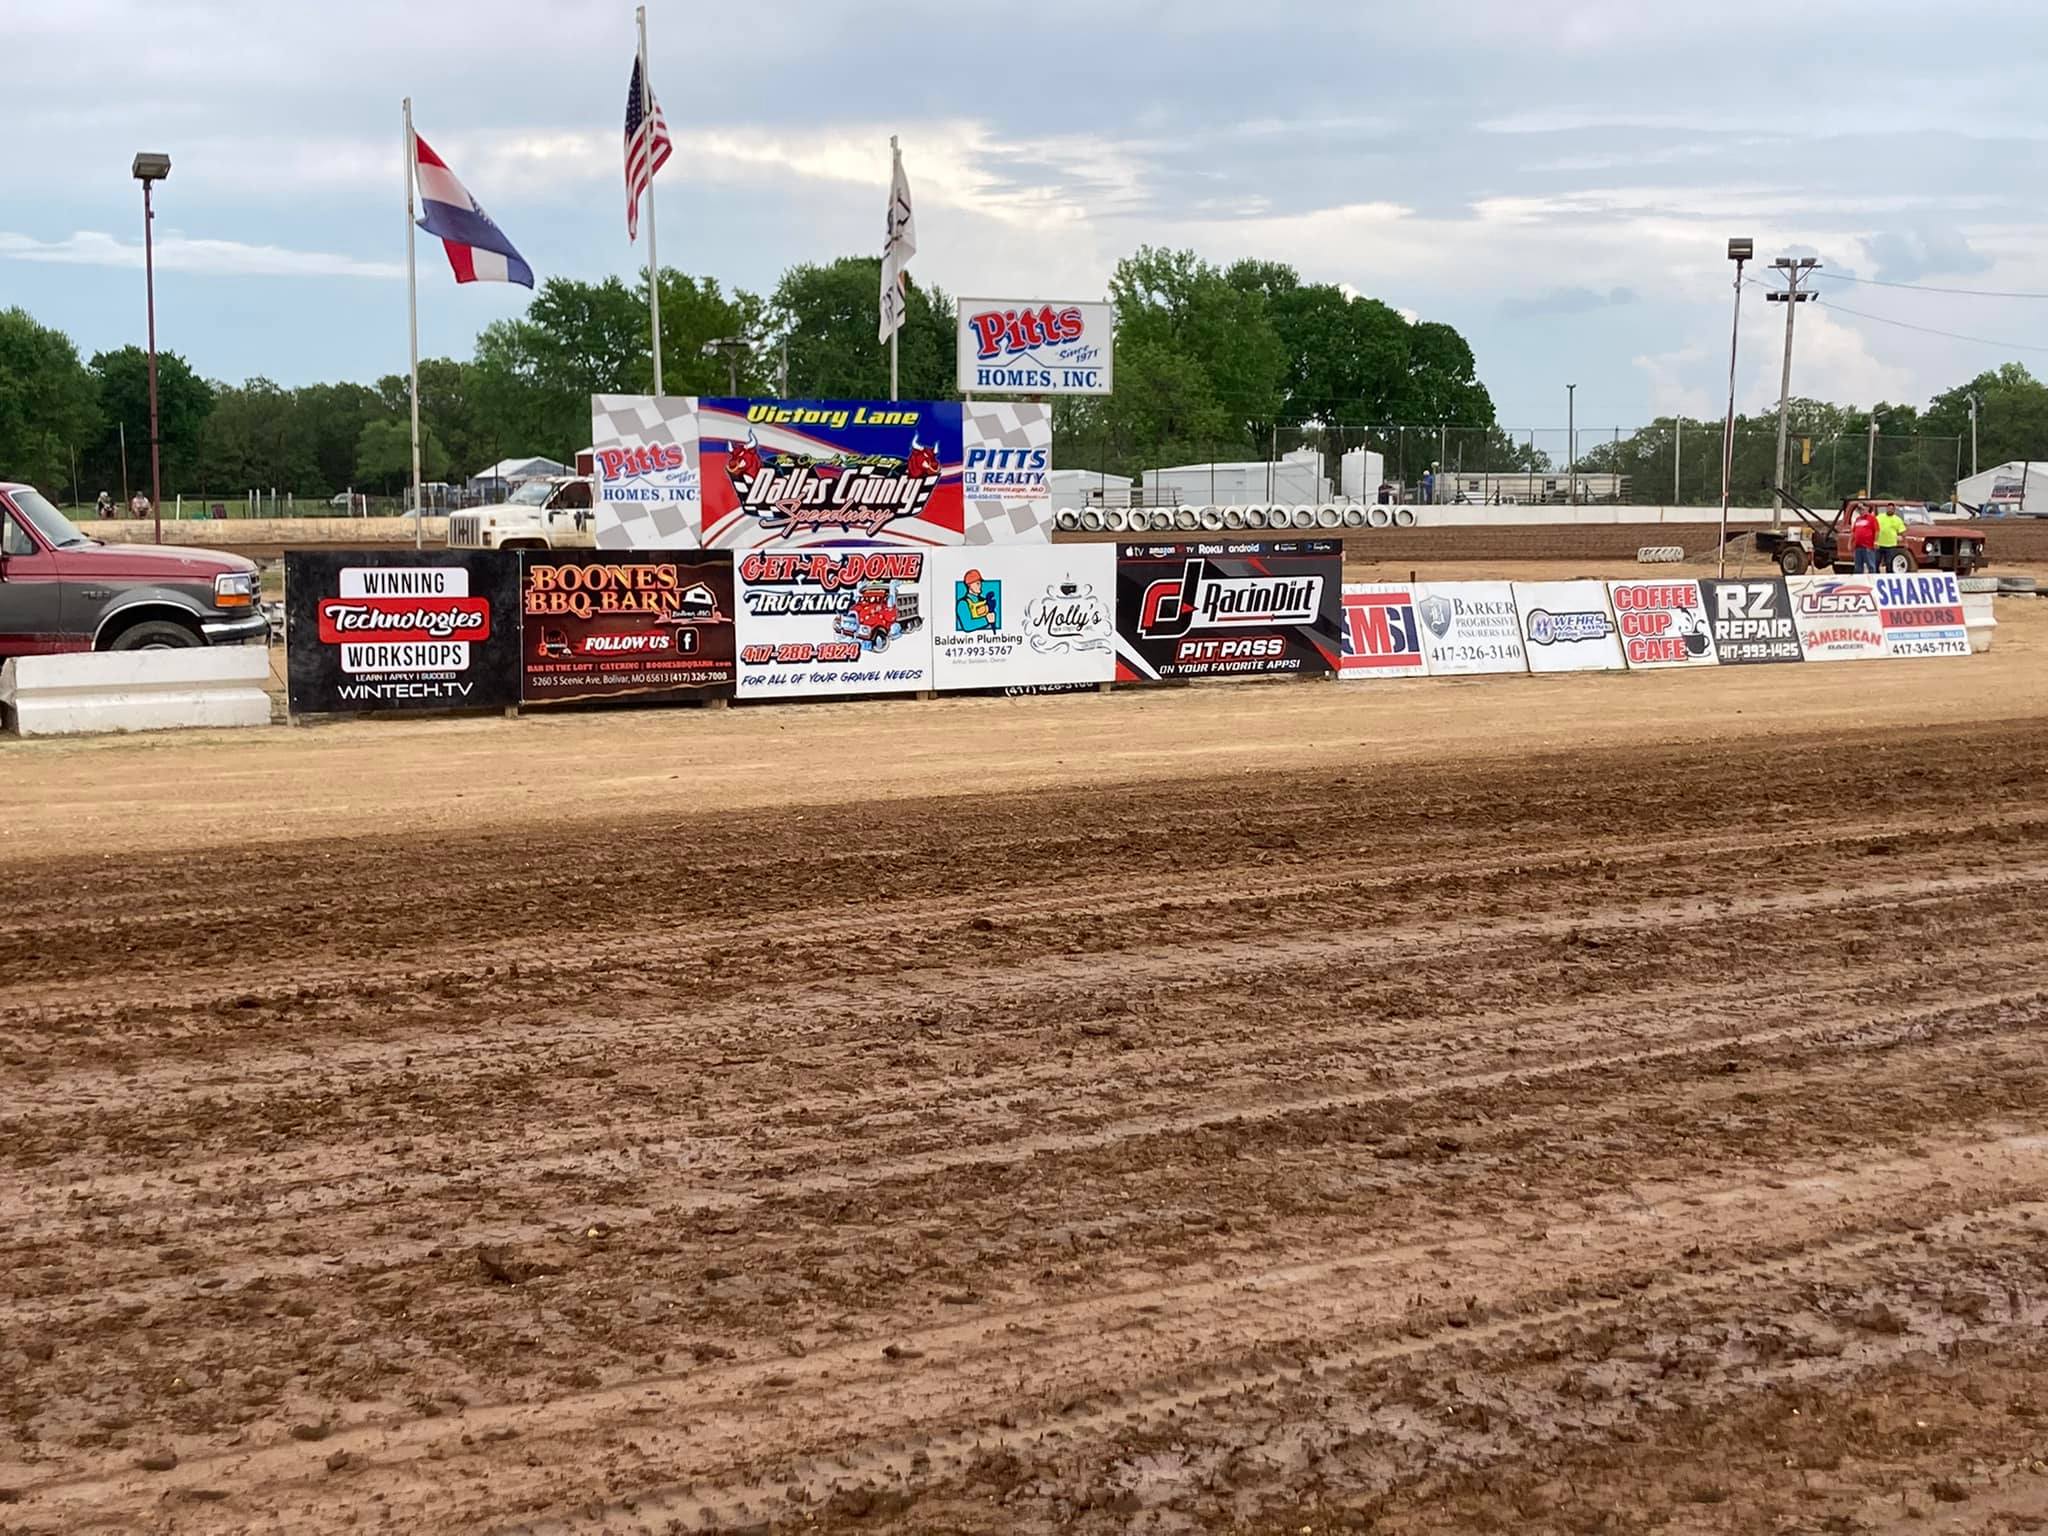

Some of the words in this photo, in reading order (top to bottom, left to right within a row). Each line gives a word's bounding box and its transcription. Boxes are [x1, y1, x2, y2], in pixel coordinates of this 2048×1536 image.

[968, 304, 1085, 360] Pitts
[1059, 345, 1090, 361] Since
[1075, 349, 1099, 364] 1971
[977, 369, 1057, 389] HOMES,
[1063, 370, 1103, 388] INC.
[746, 405, 850, 429] Victory
[853, 407, 920, 426] Lane
[595, 443, 685, 482] Pitts
[967, 448, 1047, 468] PITTS
[983, 472, 1045, 485] REALTY
[603, 488, 665, 502] HOMES,
[745, 467, 832, 505] Dallas
[831, 468, 924, 515] County
[759, 492, 896, 539] Speedway
[1134, 546, 1145, 556] tv
[1148, 546, 1176, 557] amazon
[1227, 543, 1260, 553] android
[363, 572, 445, 594] WINNING
[531, 565, 677, 592] BOONES
[1201, 580, 1316, 622] RacinDirt
[1613, 584, 1698, 610] COFFEE
[1715, 583, 1775, 619] RZ
[1877, 576, 1959, 607] SHARPE
[526, 590, 592, 618] BBQ
[600, 590, 682, 614] BARN
[743, 589, 851, 615] TRUCKING
[1453, 597, 1516, 616] BARKER
[1801, 593, 1878, 615] USRA
[324, 604, 483, 637] Technologies
[1032, 603, 1103, 638] Molly's
[1456, 617, 1516, 626] PROGRESSIVE
[1553, 615, 1603, 626] WEHRS
[1620, 611, 1672, 637] CUP
[1888, 609, 1956, 625] MOTORS
[1457, 629, 1500, 638] INSURERS
[1501, 628, 1518, 637] LLC
[1715, 619, 1792, 639] REPAIR
[1807, 628, 1882, 650] AMERICAN
[584, 636, 649, 651] FOLLOW
[649, 635, 670, 650] US
[934, 635, 974, 646] Baldwin
[977, 634, 1023, 646] Plumbing
[1178, 641, 1219, 660] PIT
[1220, 639, 1284, 657] PASS
[1627, 637, 1690, 663] CAFE
[1892, 641, 1966, 655] 417-345-7712
[347, 644, 462, 668] WORKSHOPS
[740, 643, 861, 664] 417-288-1924
[945, 646, 1013, 657] 417-993-5767
[1432, 644, 1521, 661] 417-326-3140
[1719, 642, 1799, 659] 417-993-1425
[355, 673, 383, 682] LEARN
[389, 672, 415, 681] APPLY
[421, 671, 457, 680] SUCCEED
[573, 663, 594, 672] LOFT
[1159, 664, 1175, 675] ON
[1177, 663, 1208, 674] YOUR
[1211, 660, 1264, 672] FAVORITE
[1266, 658, 1301, 669] APPS!
[532, 675, 552, 687] 5260
[552, 675, 559, 686] S
[559, 675, 585, 686] Scenic
[603, 673, 631, 685] Bolivar,
[631, 673, 645, 684] MO
[645, 673, 669, 683] 65613
[670, 672, 690, 683] (417)
[741, 674, 766, 686] FOR
[768, 674, 787, 685] ALL
[790, 673, 807, 684] OF
[809, 671, 838, 683] YOUR
[840, 670, 881, 682] GRAVEL
[883, 669, 923, 681] NEEDS
[337, 681, 474, 700] WINTECH.TV
